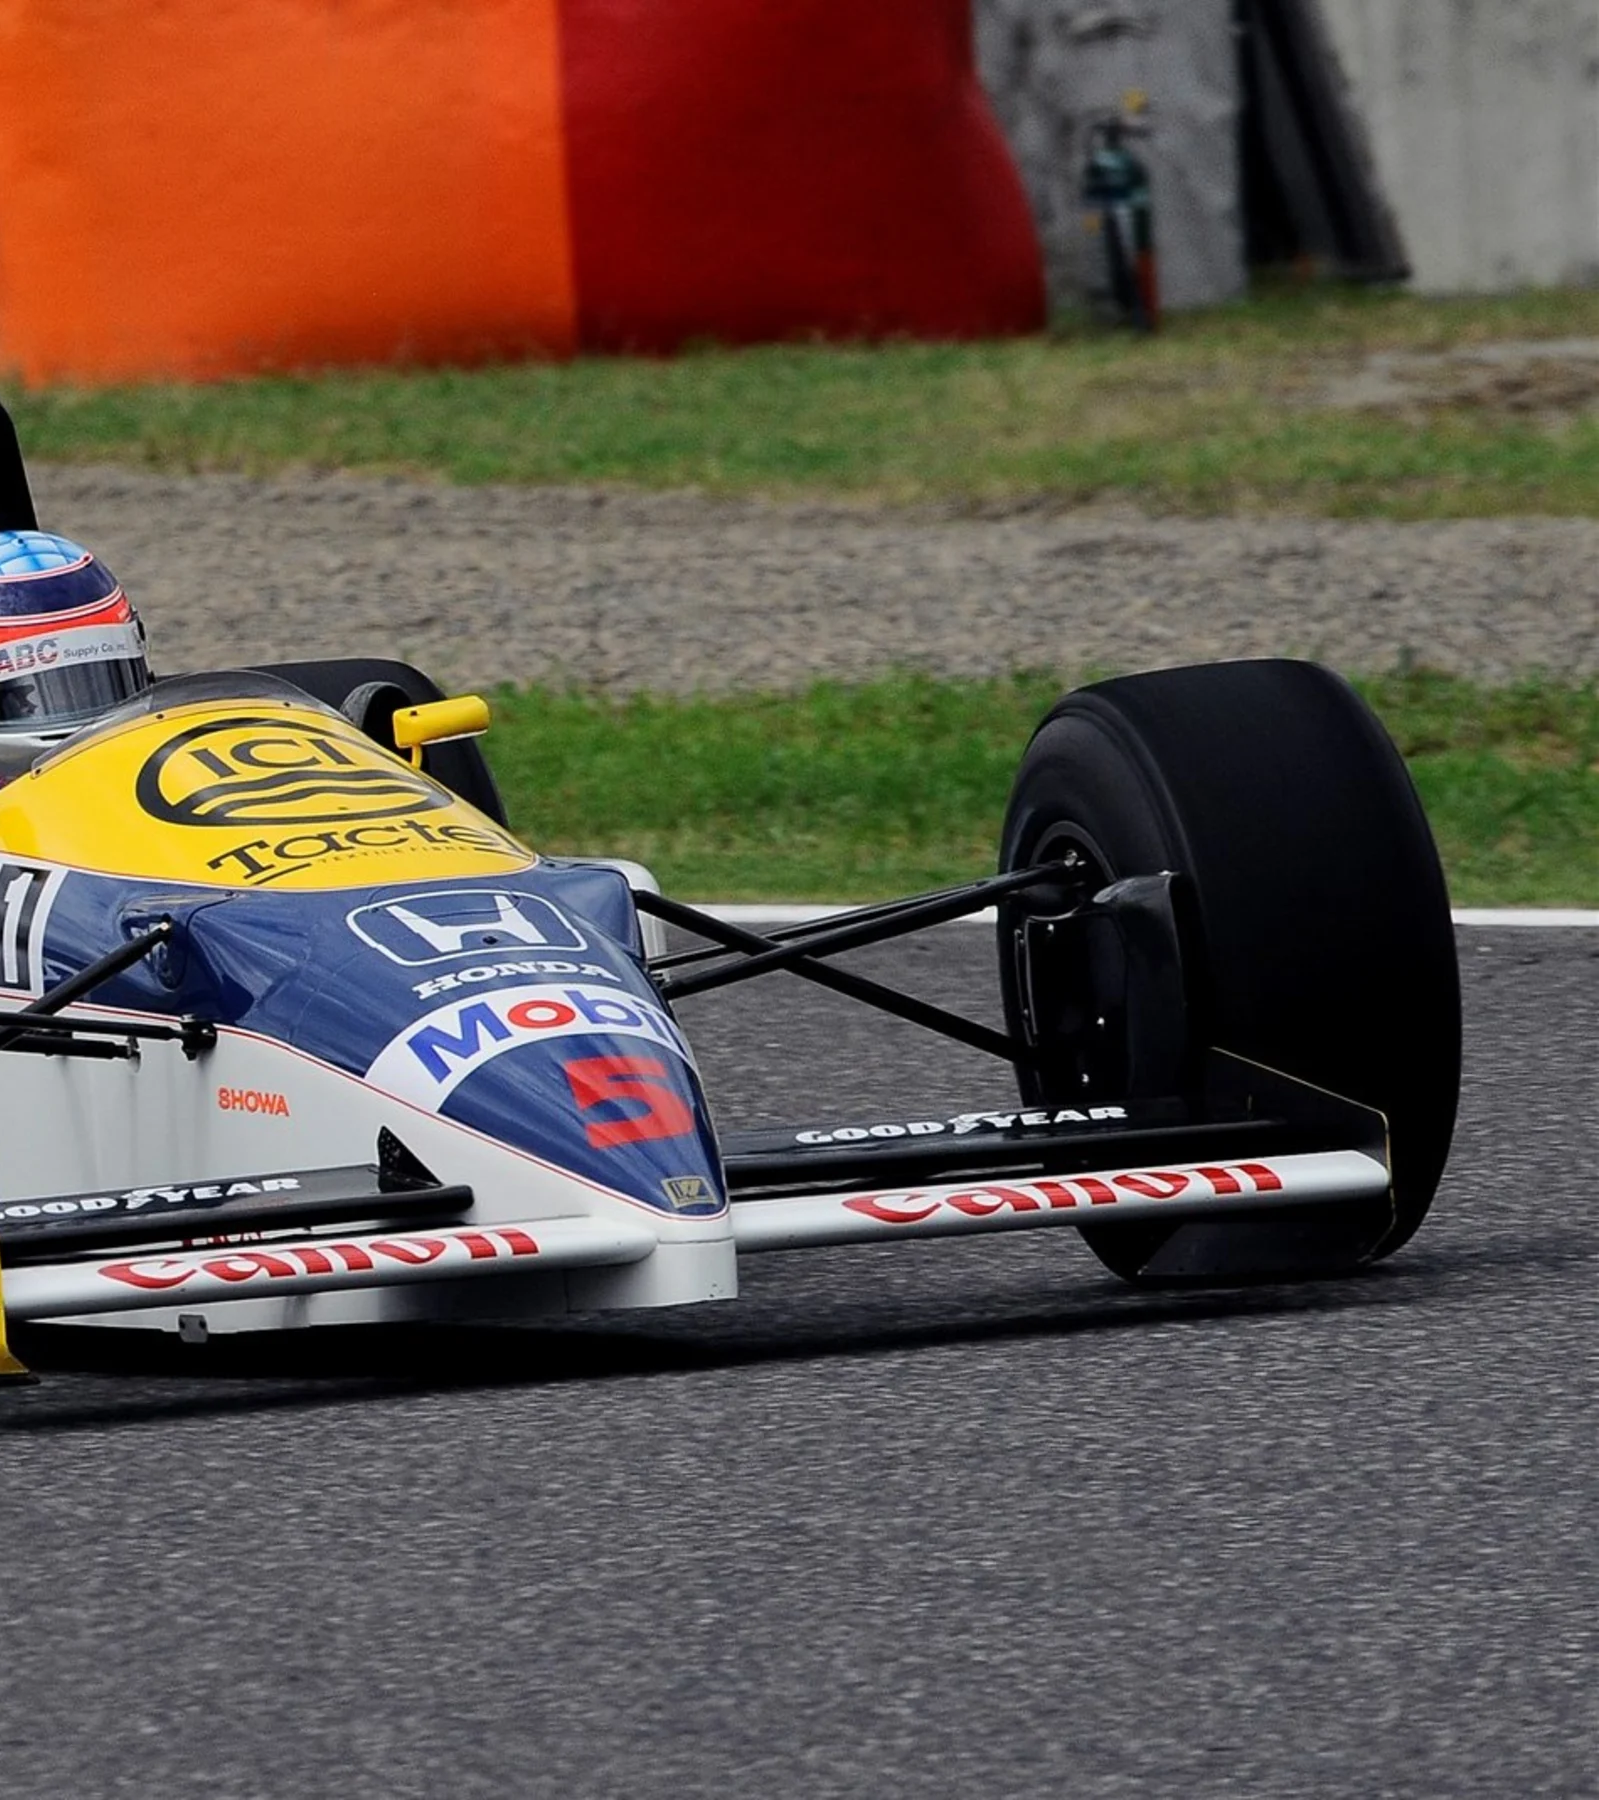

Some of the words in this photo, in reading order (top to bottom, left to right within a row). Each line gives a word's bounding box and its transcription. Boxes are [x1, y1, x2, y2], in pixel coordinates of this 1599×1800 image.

[63, 644, 99, 659] Supply
[187, 738, 357, 779] ICI
[412, 960, 621, 1000] HONDA
[406, 989, 688, 1084] Mobil
[218, 1087, 290, 1117] SHOWA
[564, 1055, 695, 1149] 5
[841, 1162, 1283, 1225] Canon
[98, 1228, 540, 1290] Canon
